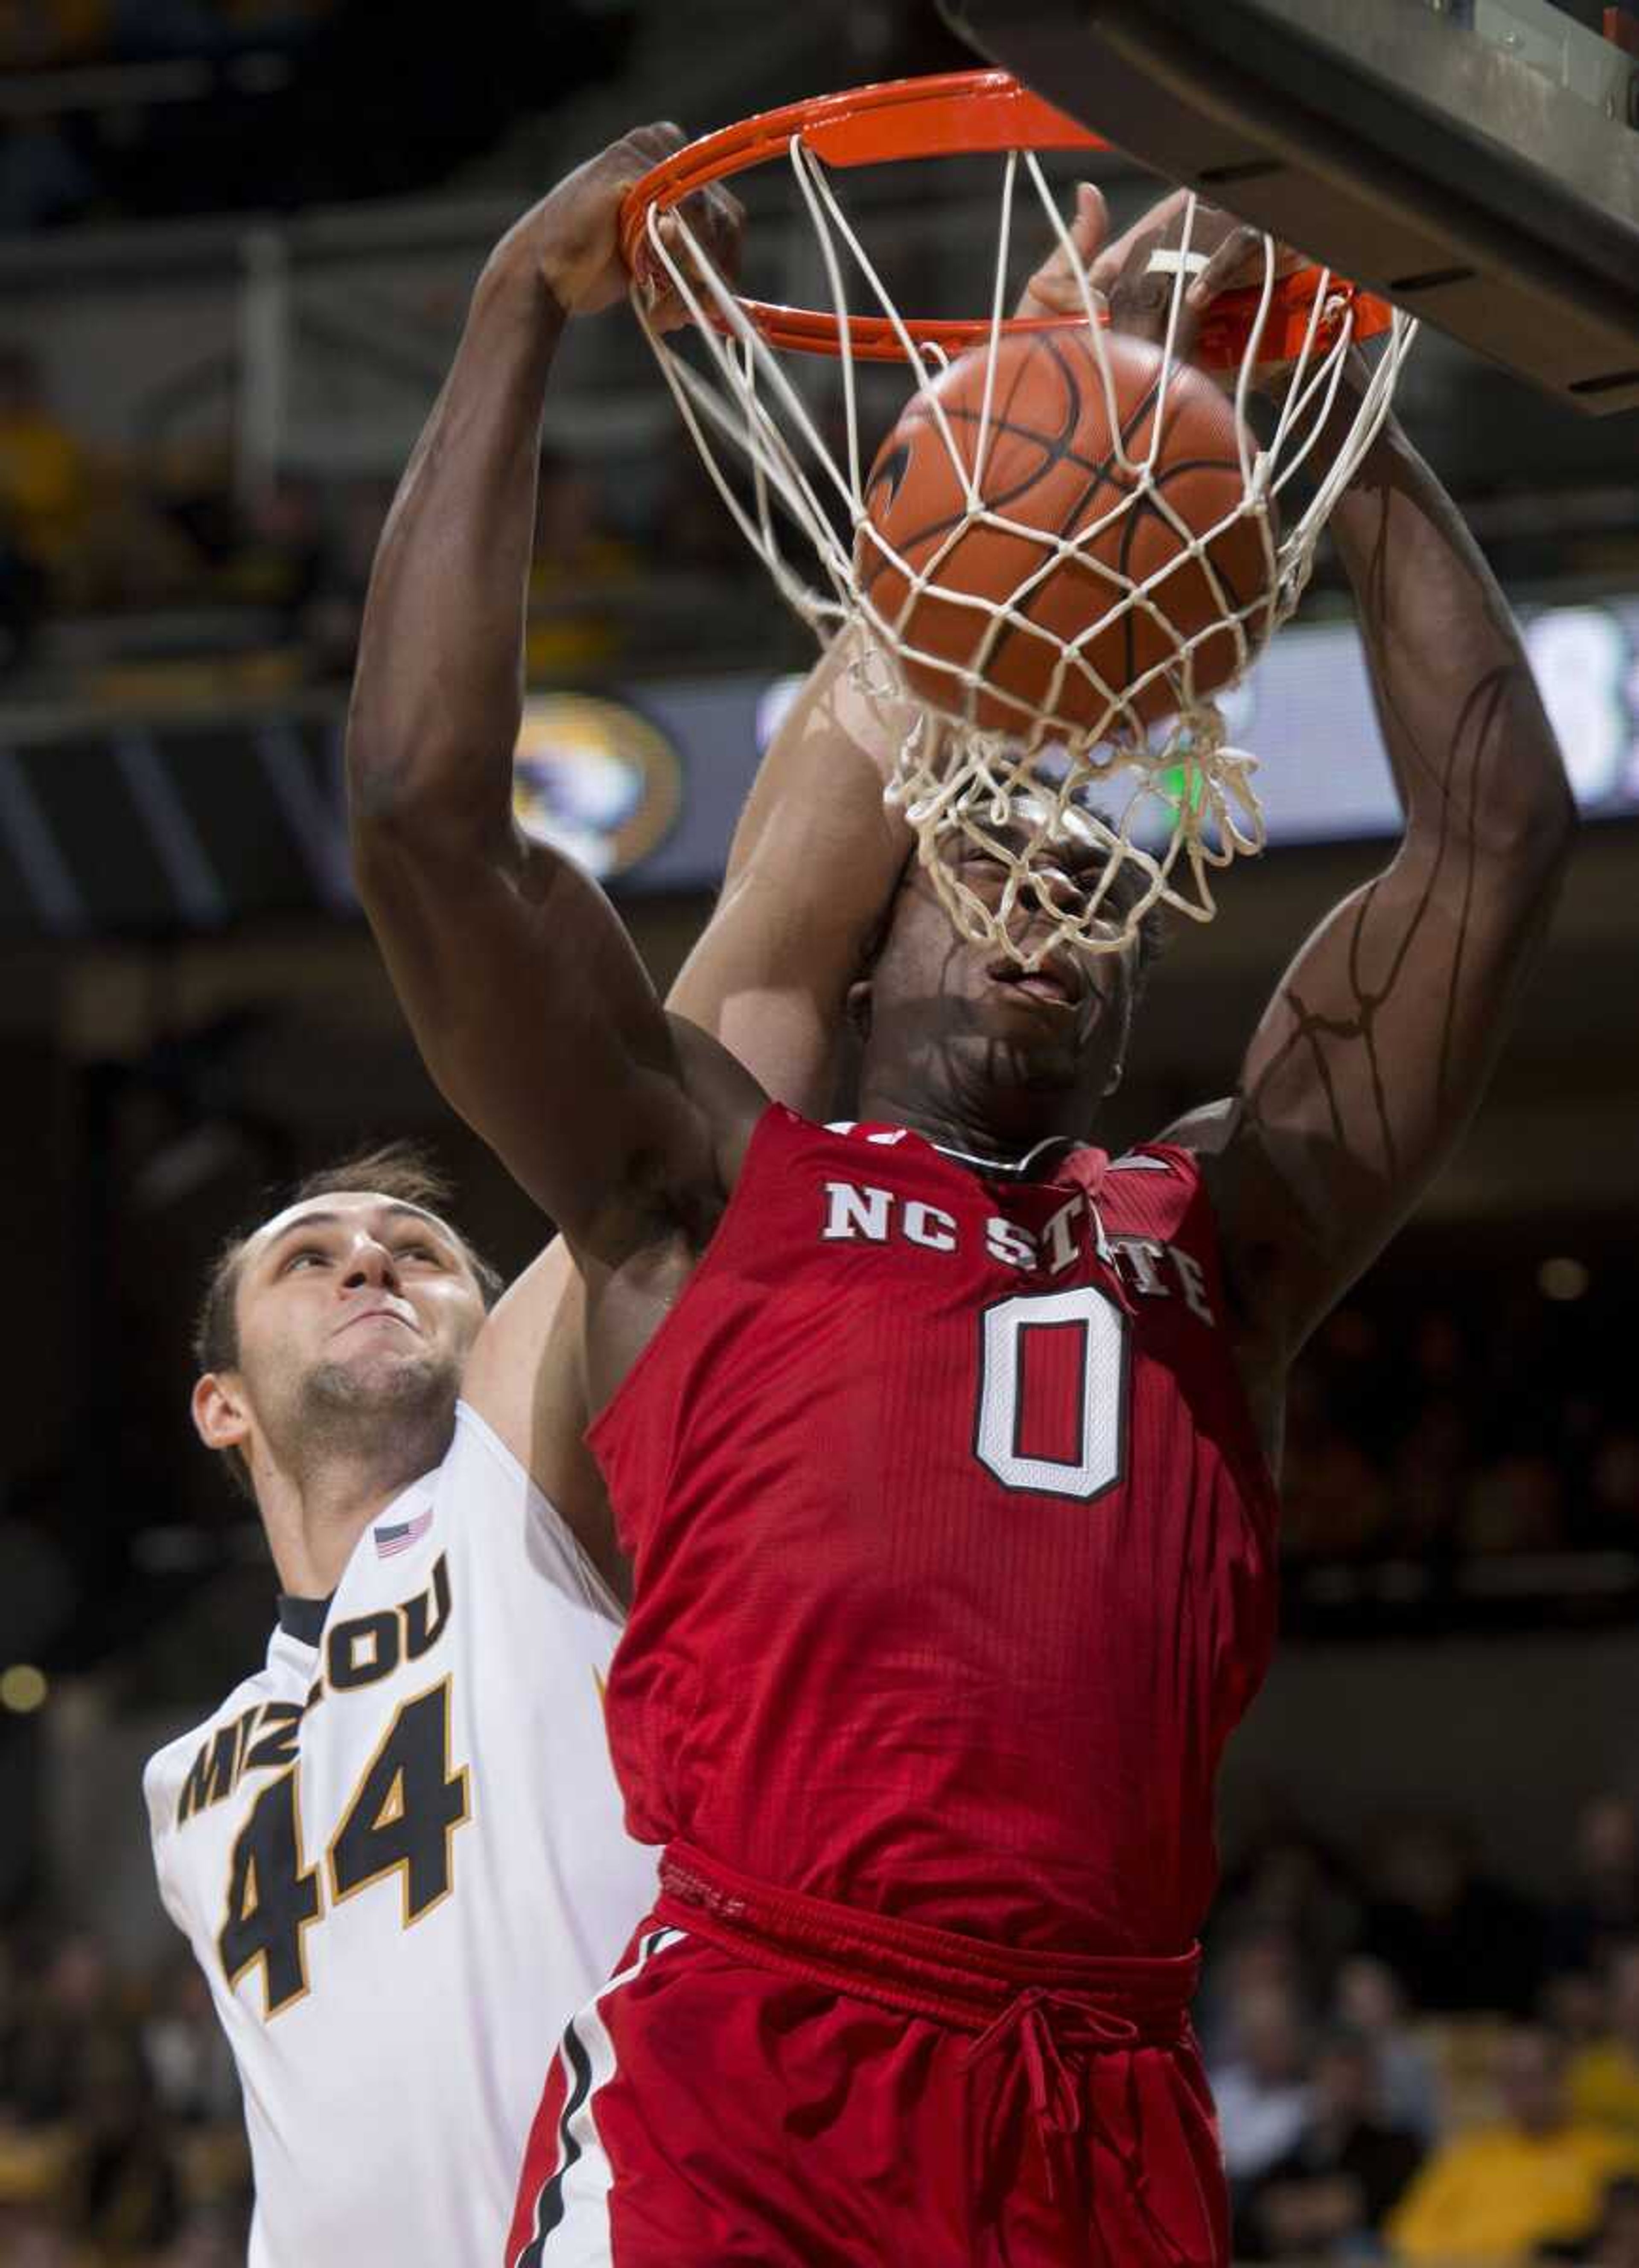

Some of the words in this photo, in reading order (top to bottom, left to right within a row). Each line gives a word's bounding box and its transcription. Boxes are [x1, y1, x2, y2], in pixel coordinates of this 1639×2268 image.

[822, 1181, 957, 1251] NC
[974, 1284, 1128, 1502] 0
[176, 1550, 452, 1831] MIZOU
[217, 1672, 472, 2022] 44
